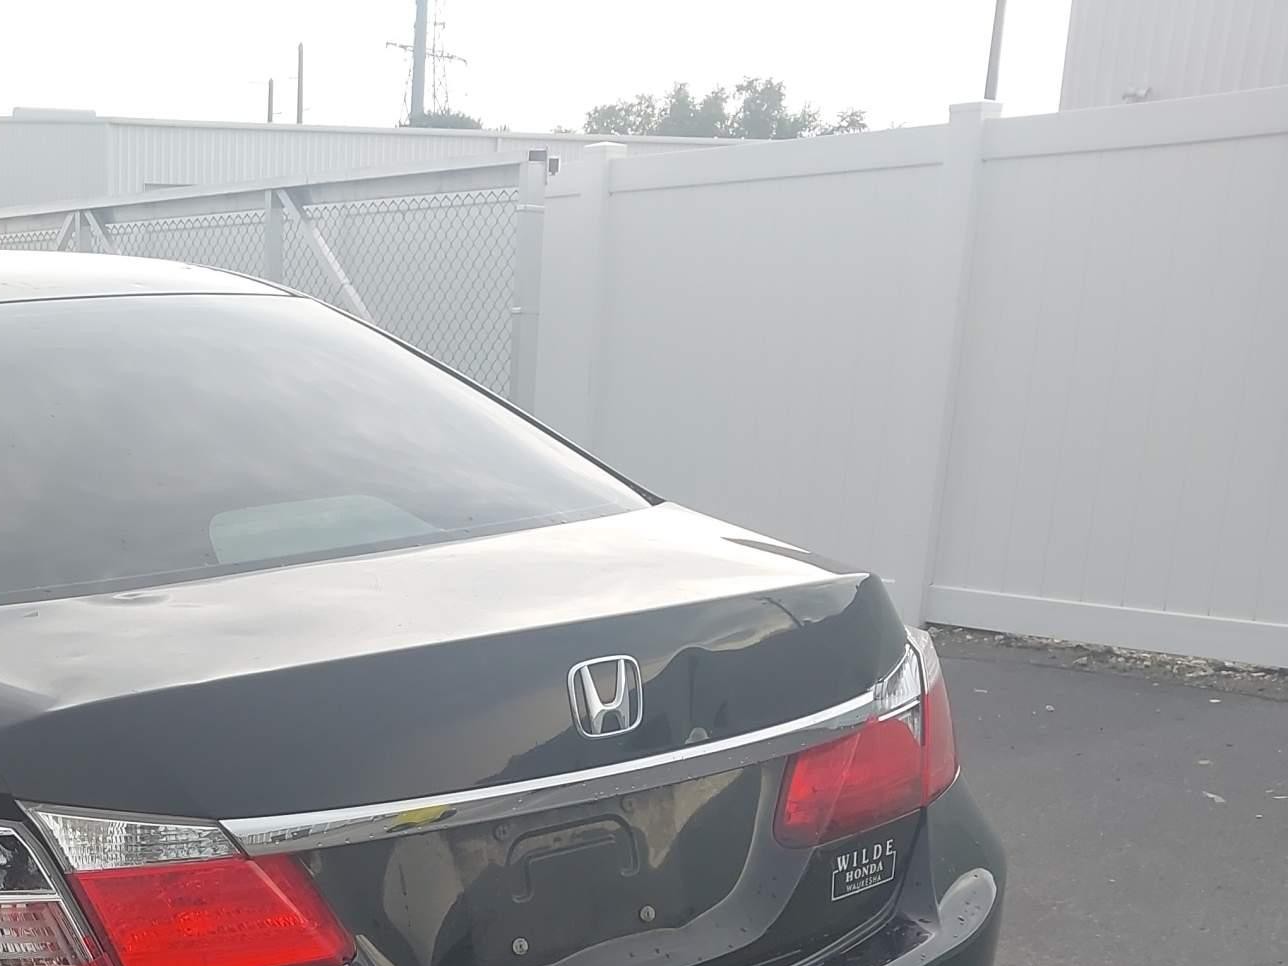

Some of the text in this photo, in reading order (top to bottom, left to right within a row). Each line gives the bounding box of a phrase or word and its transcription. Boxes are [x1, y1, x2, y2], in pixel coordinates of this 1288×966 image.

[837, 839, 894, 872] WILDE
[845, 861, 884, 883] HONDA
[846, 874, 882, 892] WAUKESHA
